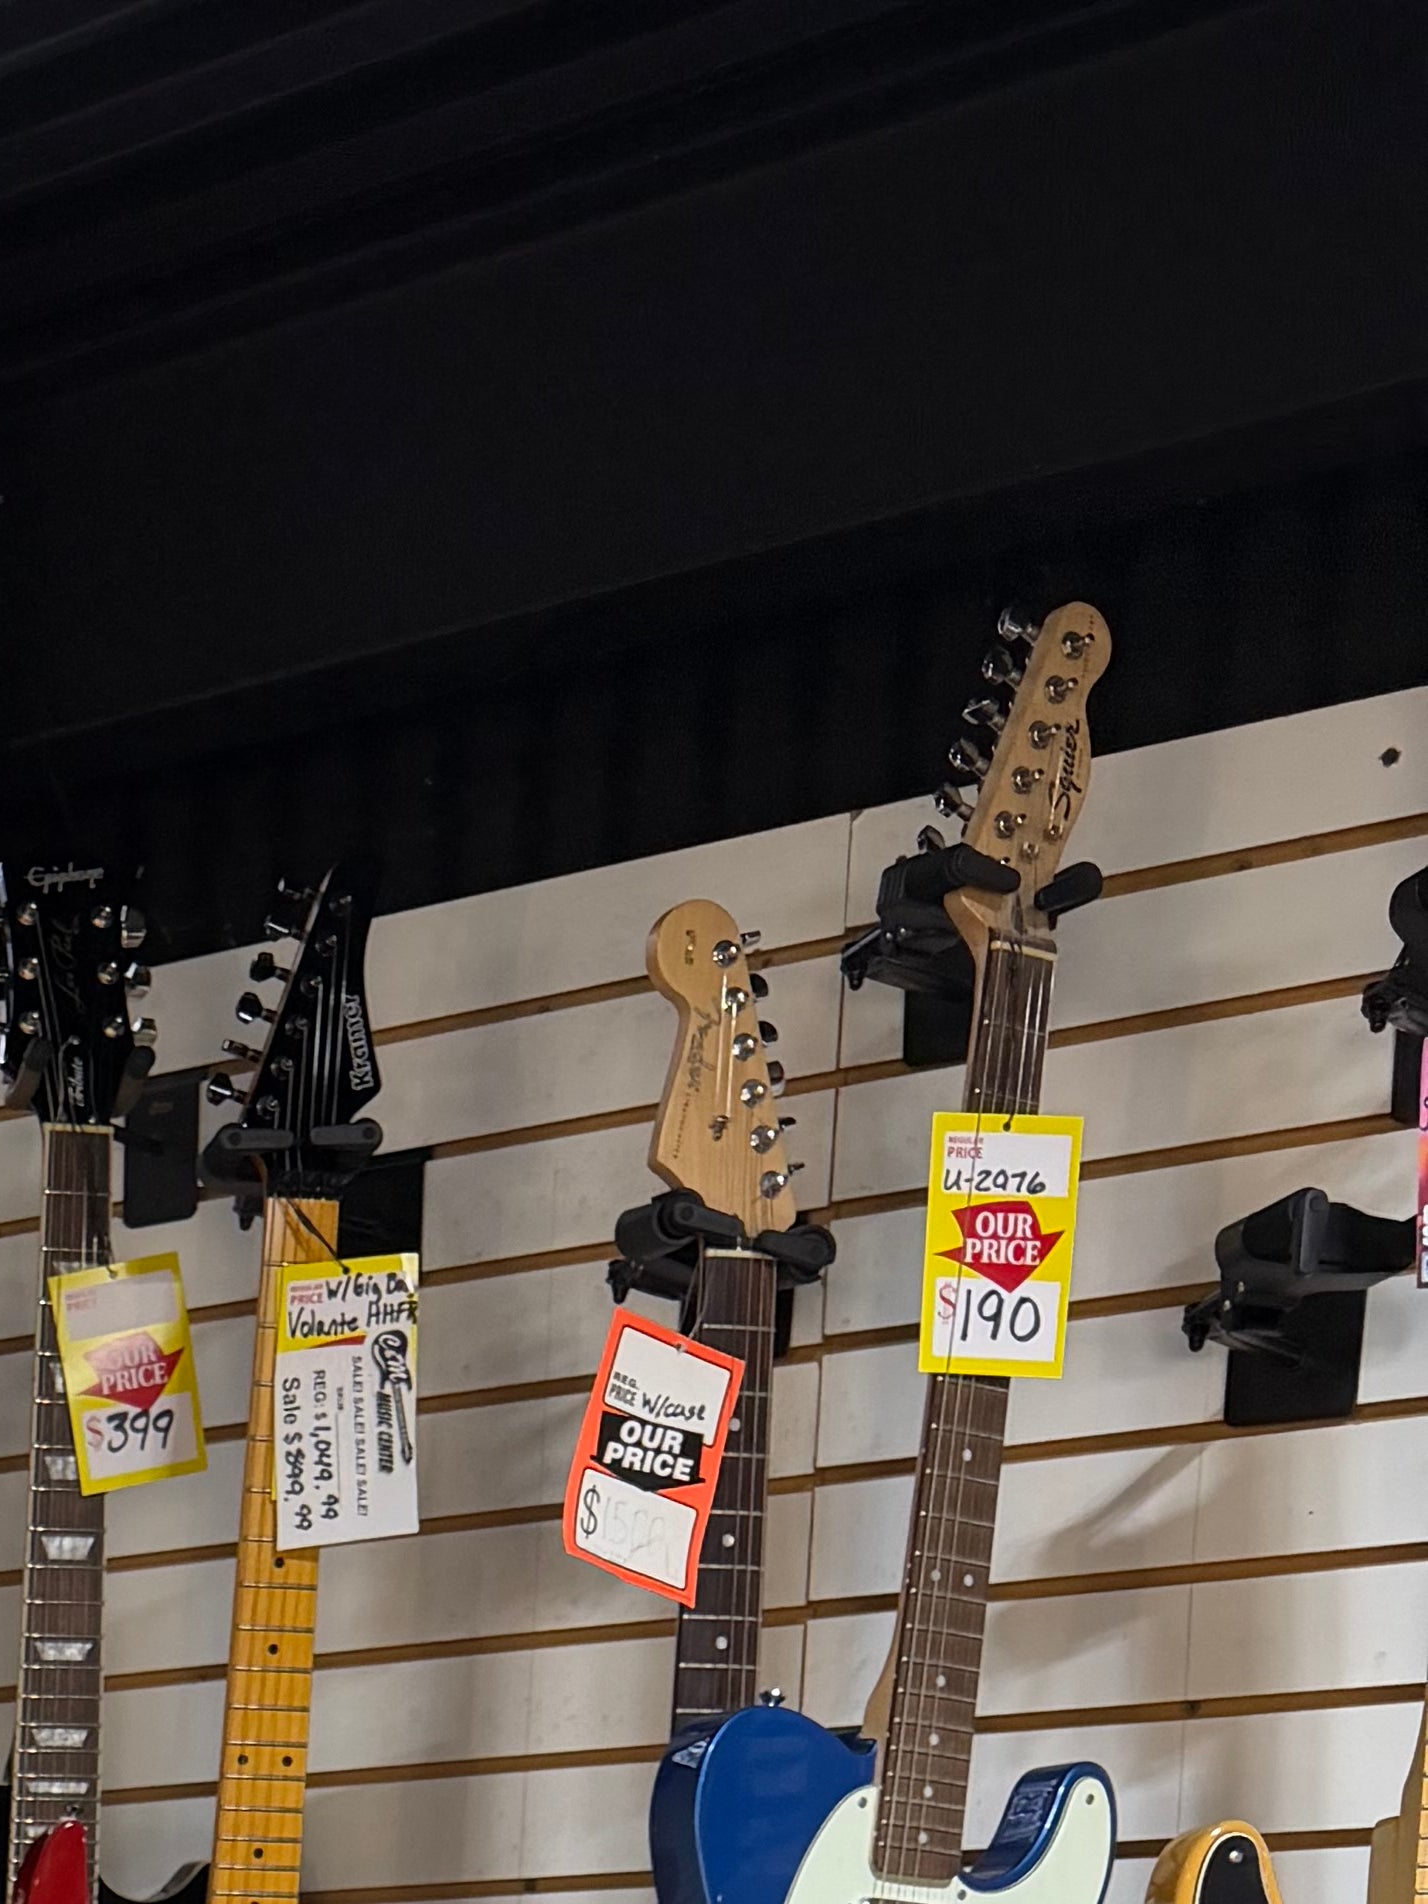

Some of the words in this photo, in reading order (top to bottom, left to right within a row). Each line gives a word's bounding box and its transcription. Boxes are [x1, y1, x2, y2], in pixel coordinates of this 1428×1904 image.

[1048, 718, 1082, 822] Squier
[24, 861, 106, 895] Epiphone
[342, 993, 375, 1091] Kramer
[947, 1147, 984, 1159] PRICE
[975, 1211, 1033, 1239] OUR
[964, 1239, 1042, 1266] PRICE
[101, 1362, 168, 1395] PRICE
[608, 1382, 637, 1408] PRICE
[282, 1377, 301, 1425] Sale
[619, 1419, 685, 1455] OUR
[601, 1441, 695, 1483] PRICE
